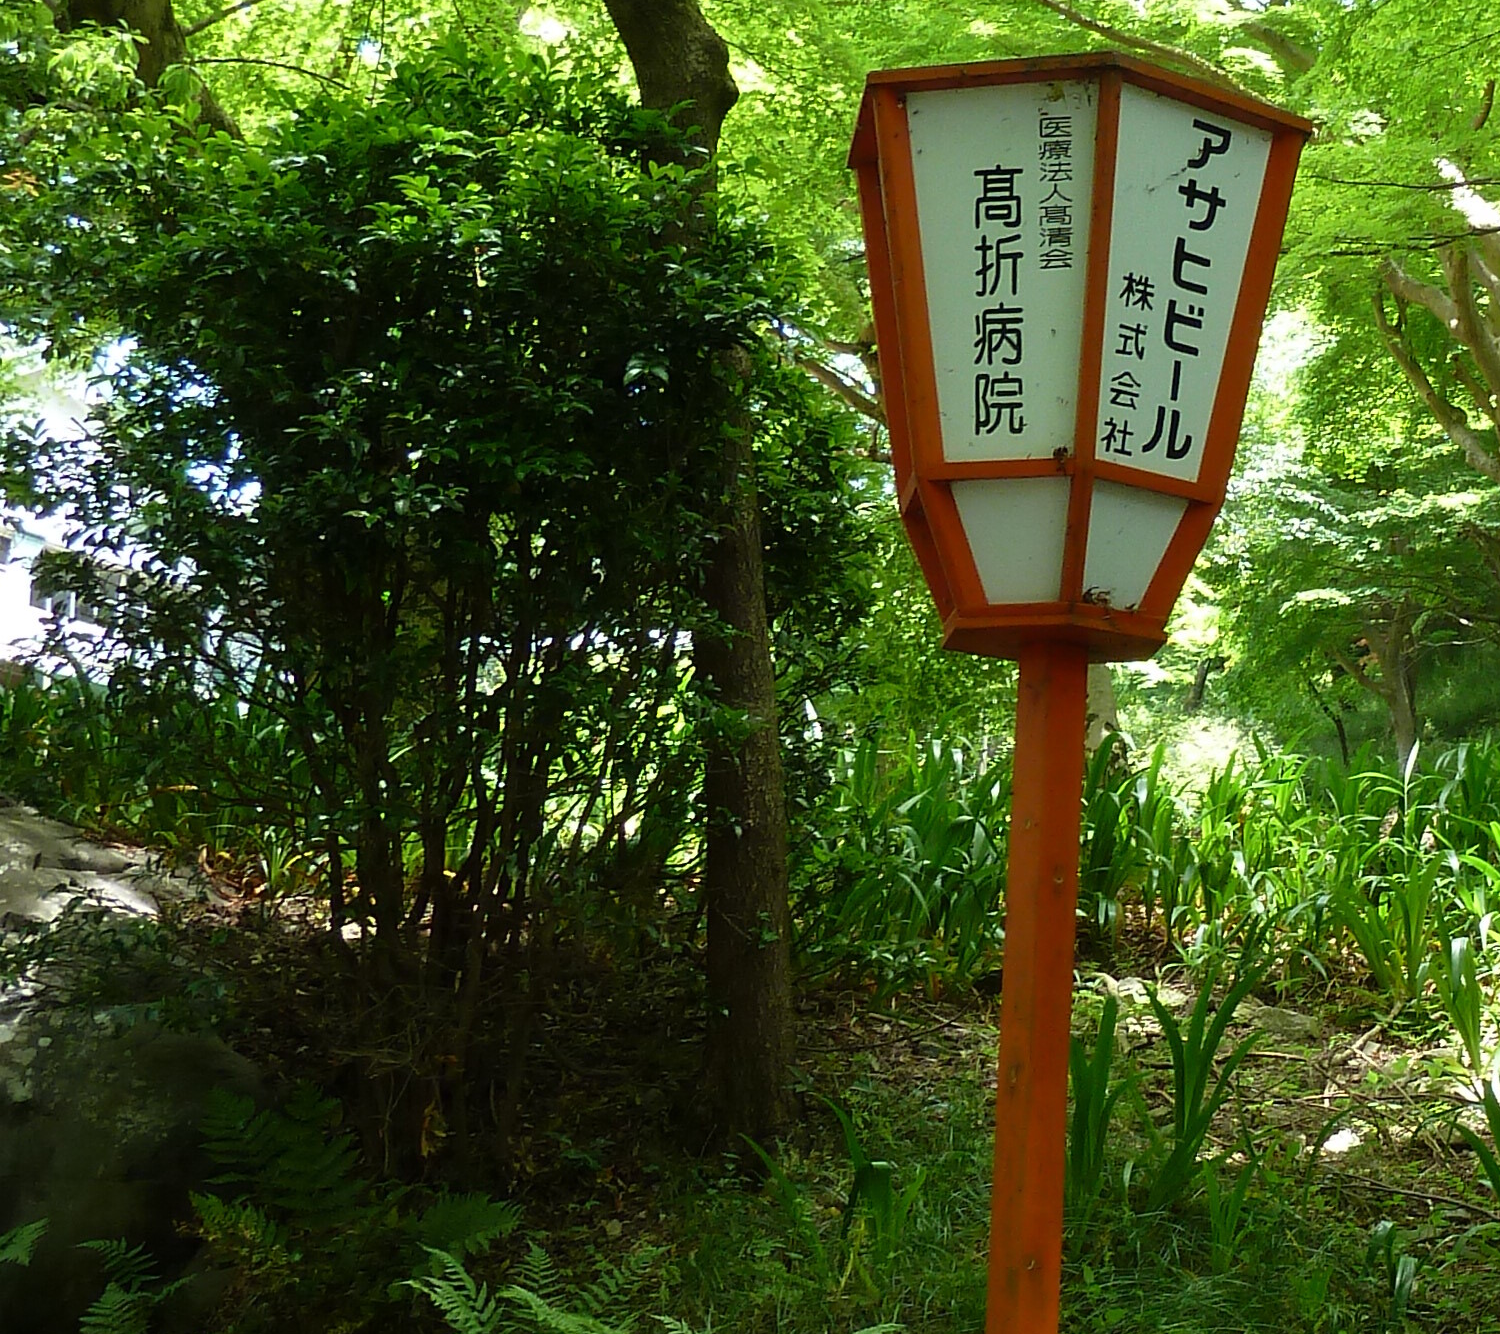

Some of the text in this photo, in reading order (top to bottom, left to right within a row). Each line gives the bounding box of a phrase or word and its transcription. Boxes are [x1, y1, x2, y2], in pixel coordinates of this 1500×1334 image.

[1101, 271, 1155, 458] 株式会社
[1142, 118, 1232, 461] アサヒビール
